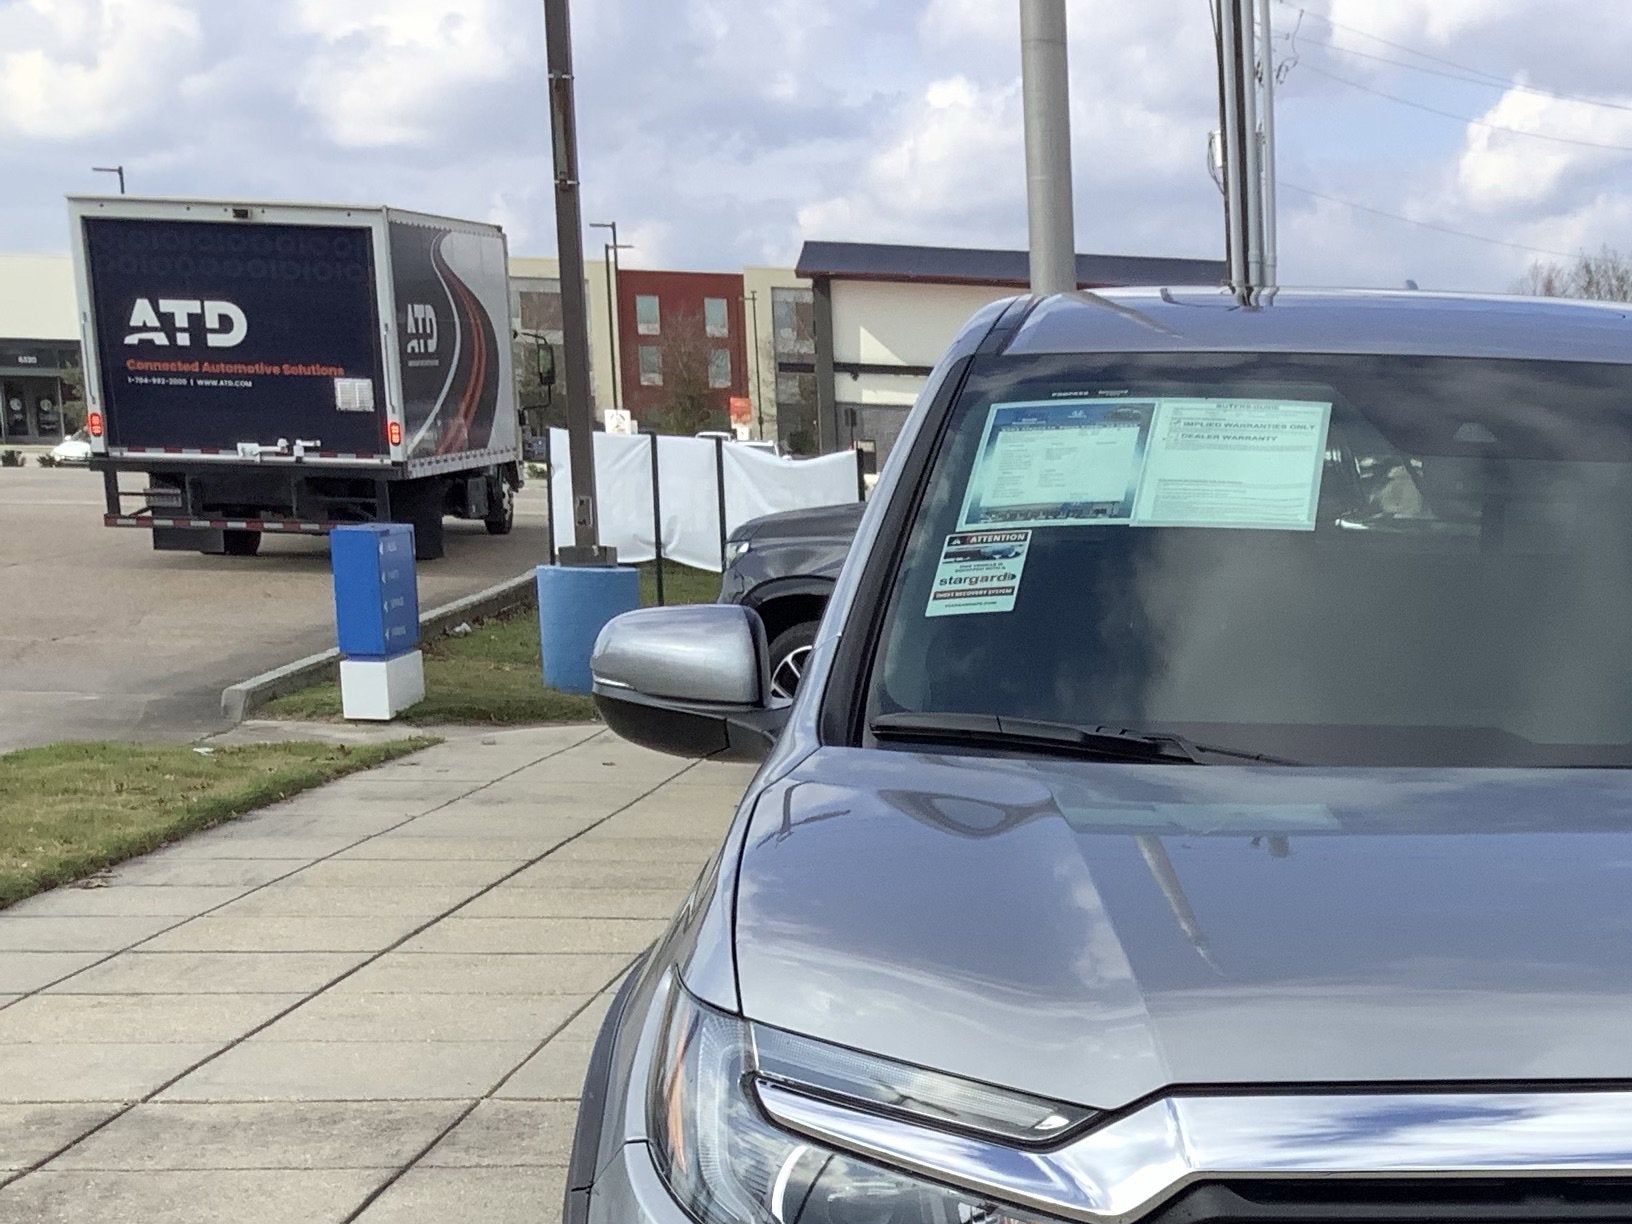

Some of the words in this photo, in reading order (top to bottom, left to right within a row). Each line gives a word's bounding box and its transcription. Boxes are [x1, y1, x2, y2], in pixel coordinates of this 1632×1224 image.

[124, 298, 248, 347] ATD
[407, 304, 438, 353] ATD
[126, 359, 199, 373] Connected
[201, 361, 281, 375] Automotive
[282, 363, 345, 377] Solutions
[1183, 421, 1222, 429] IMPLIED
[970, 533, 1026, 544] ATTENTION
